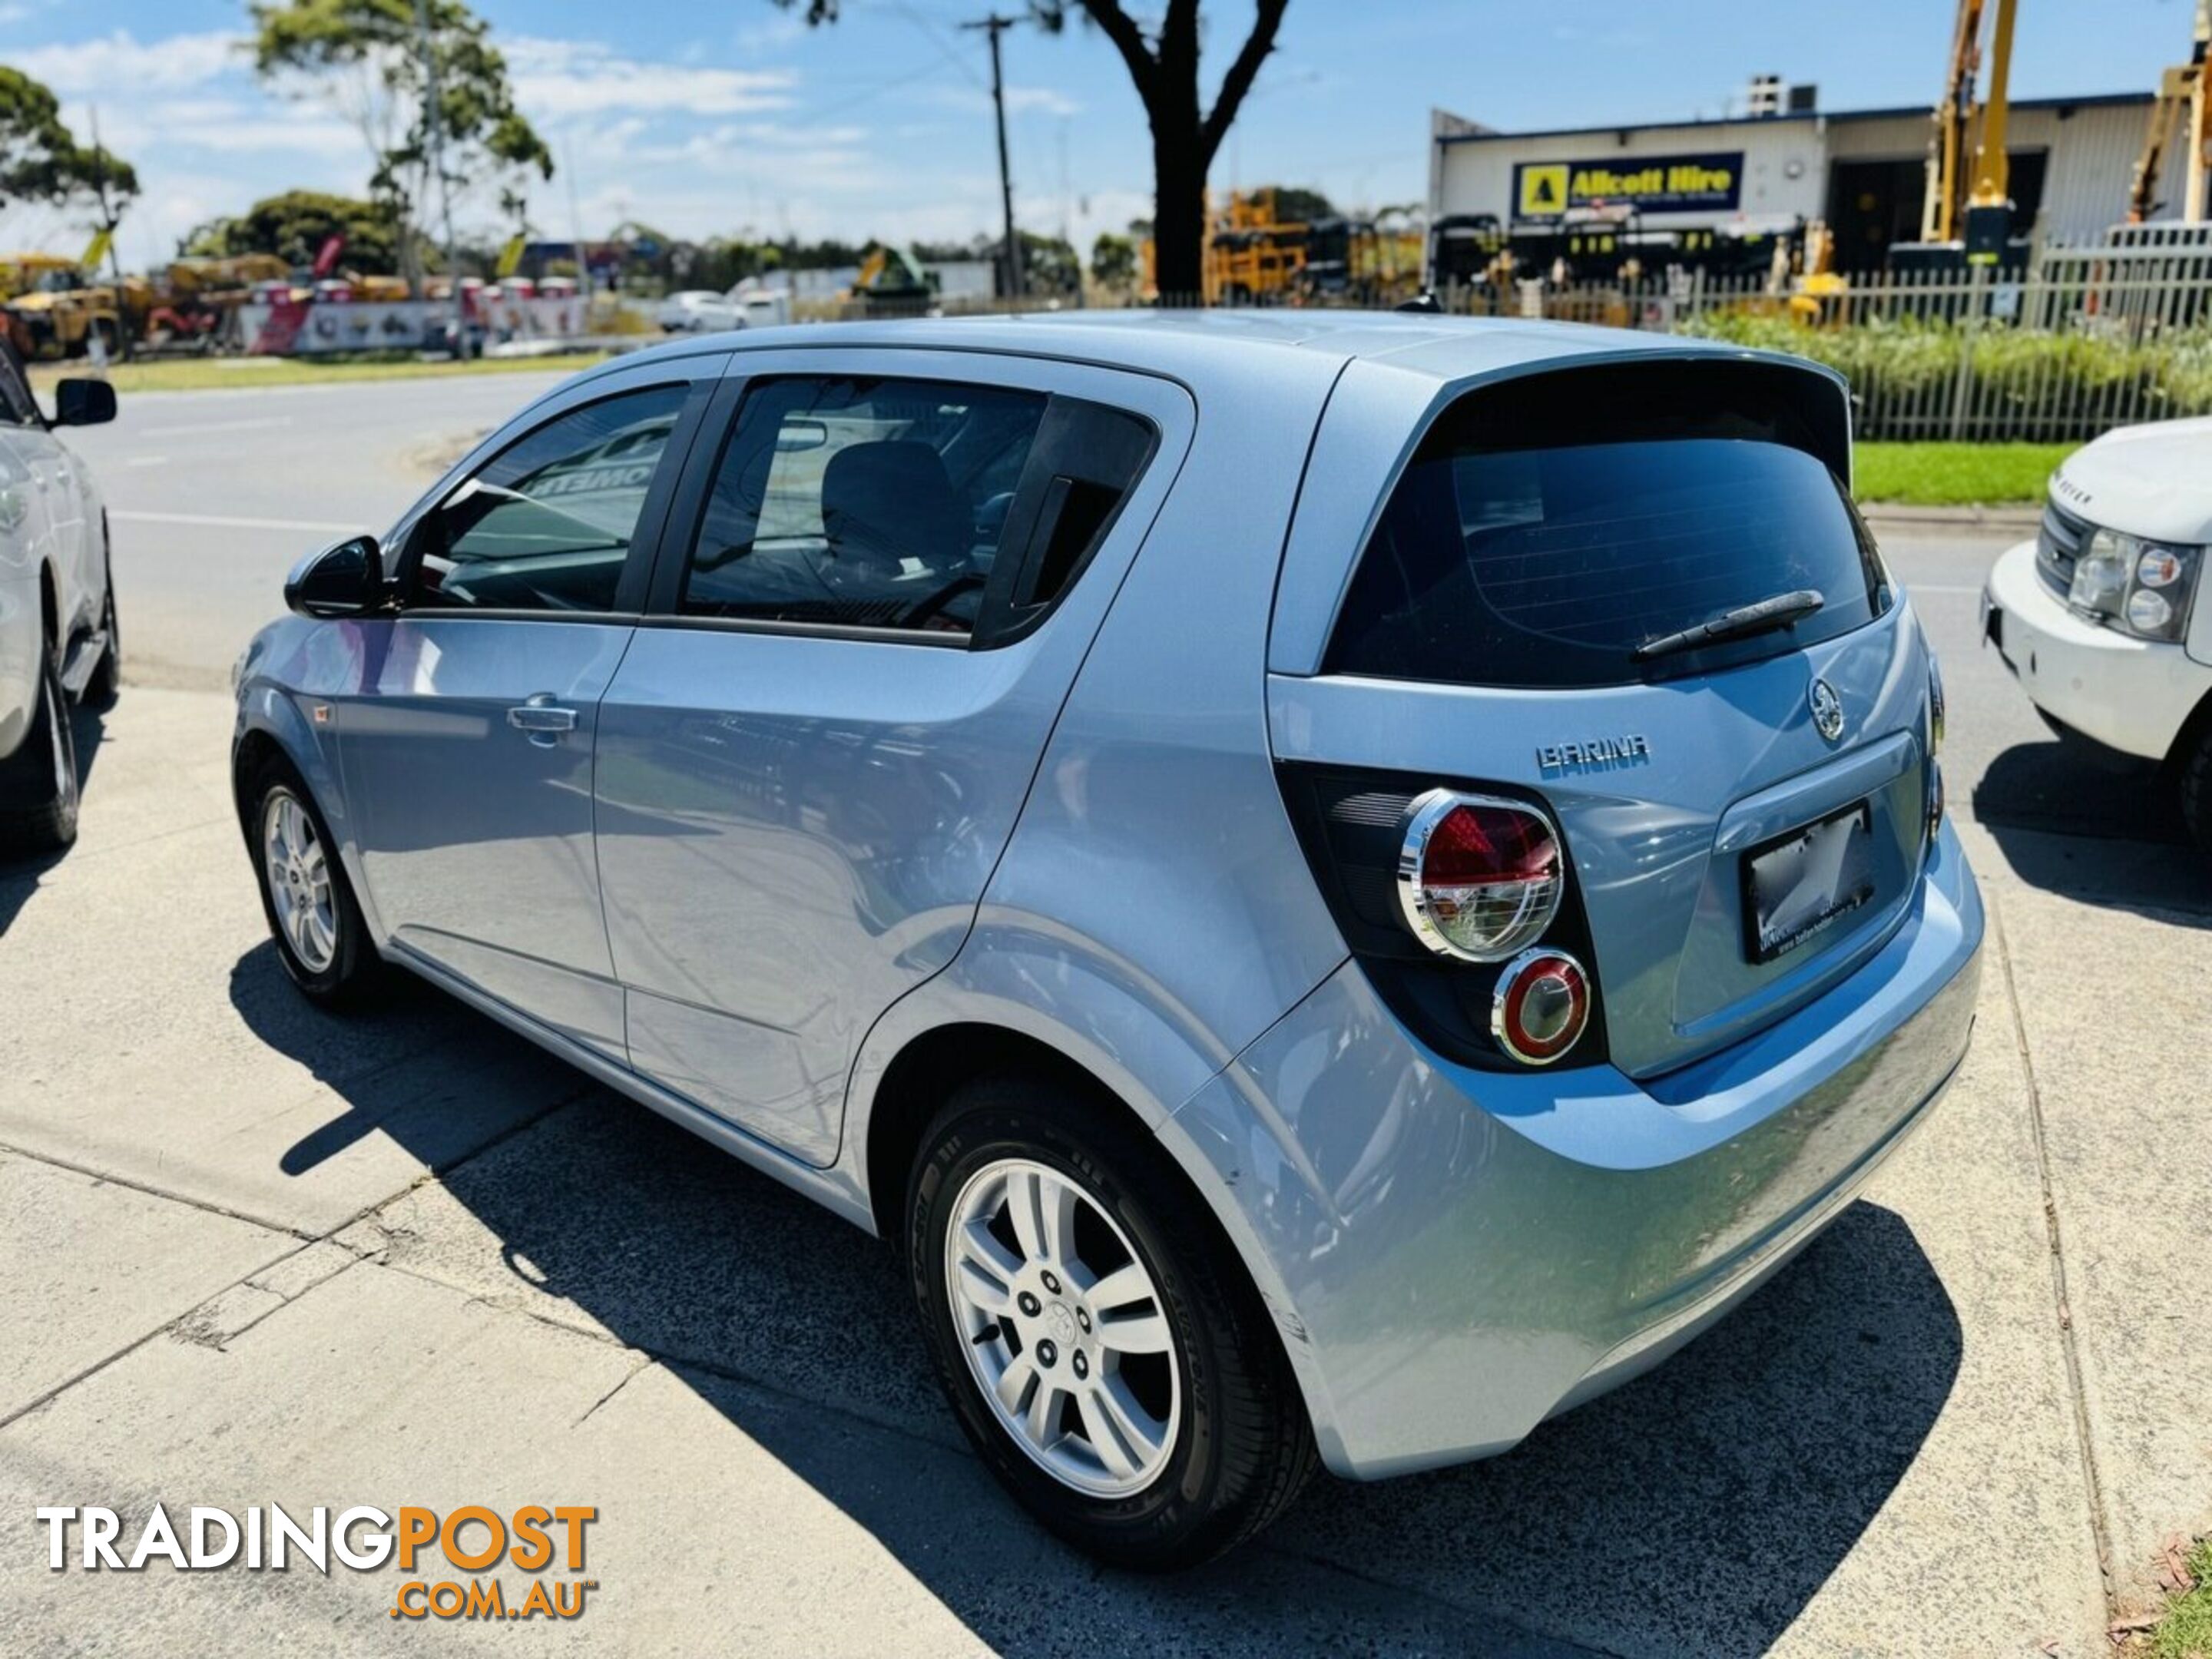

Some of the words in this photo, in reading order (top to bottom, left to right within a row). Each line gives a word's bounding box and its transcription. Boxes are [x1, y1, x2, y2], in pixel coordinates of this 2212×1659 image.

[1573, 170, 1664, 196] Allcott
[1667, 164, 1732, 192] Hire
[1537, 734, 1650, 769] BARINA
